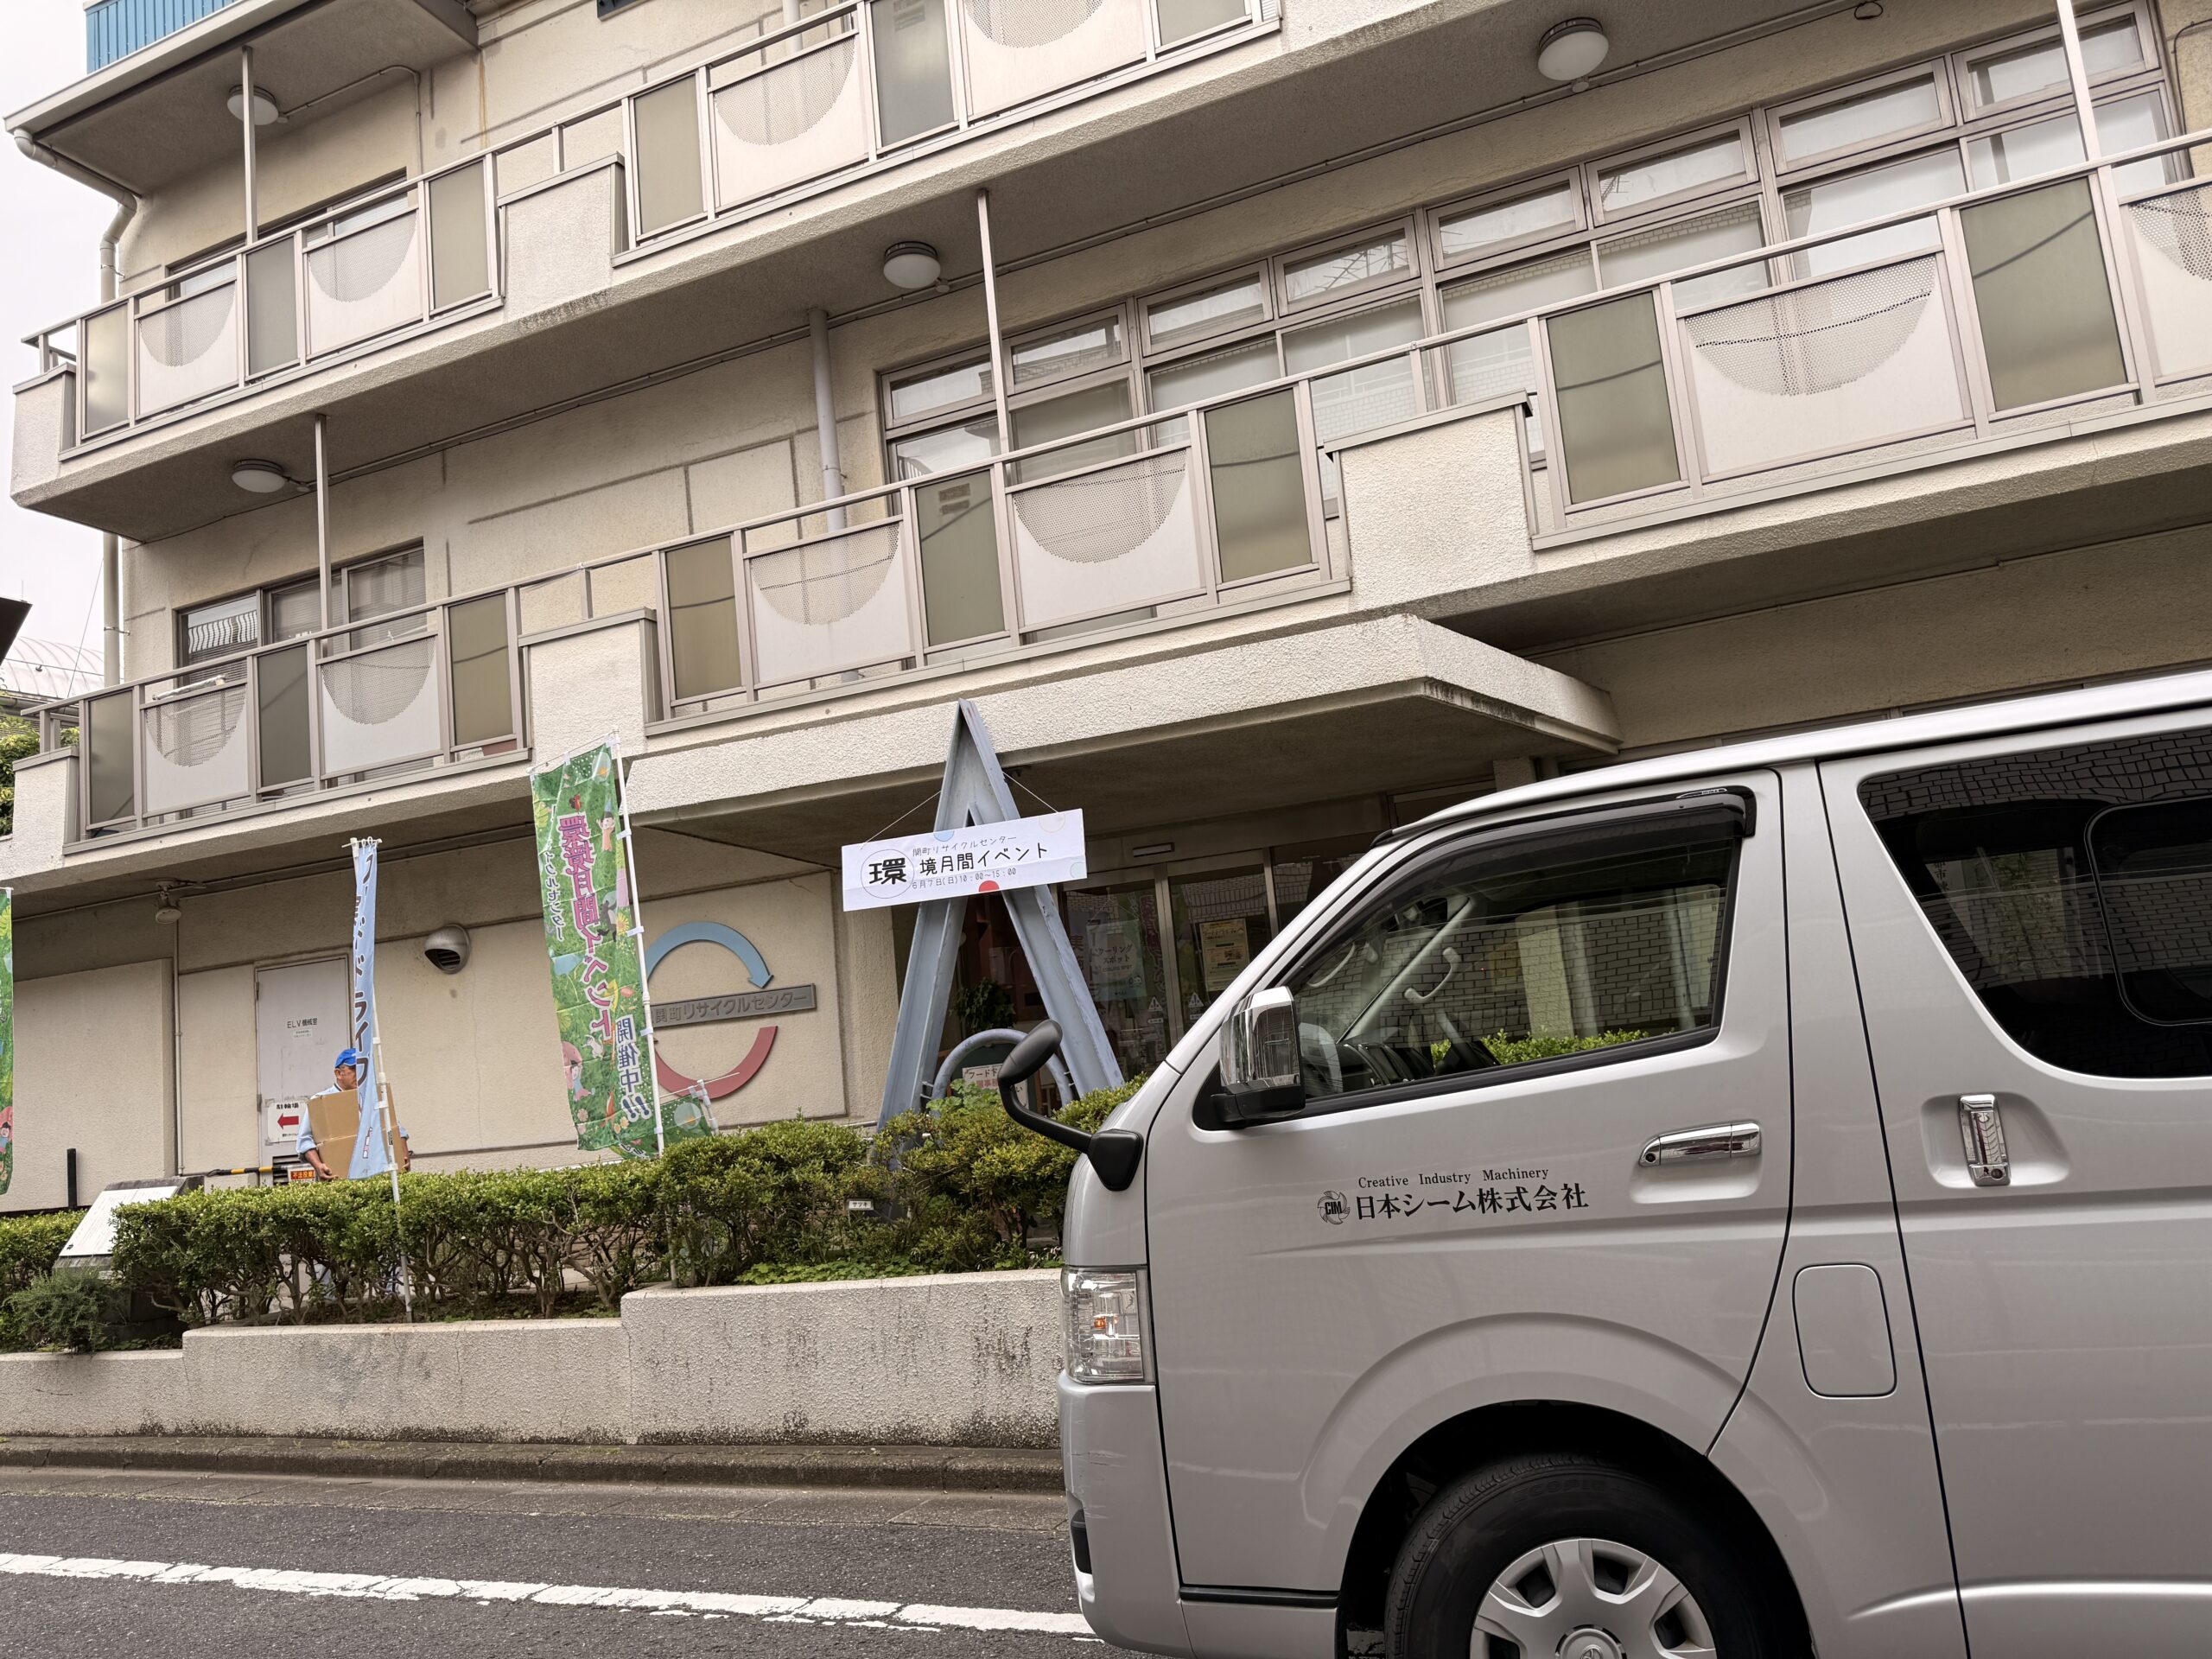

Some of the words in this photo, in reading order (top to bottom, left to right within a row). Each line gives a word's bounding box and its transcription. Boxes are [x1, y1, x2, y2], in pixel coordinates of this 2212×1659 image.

[912, 836, 1017, 857] 関町リサイクルセンター
[652, 993, 808, 1024] 関町リサイクルセンター
[1358, 1175, 1408, 1189] Creative
[1419, 1172, 1471, 1185] Industry
[1483, 1168, 1549, 1182] Machinery
[1325, 1202, 1343, 1216] CIM
[1356, 1183, 1589, 1220] 日本シーム株式会社
